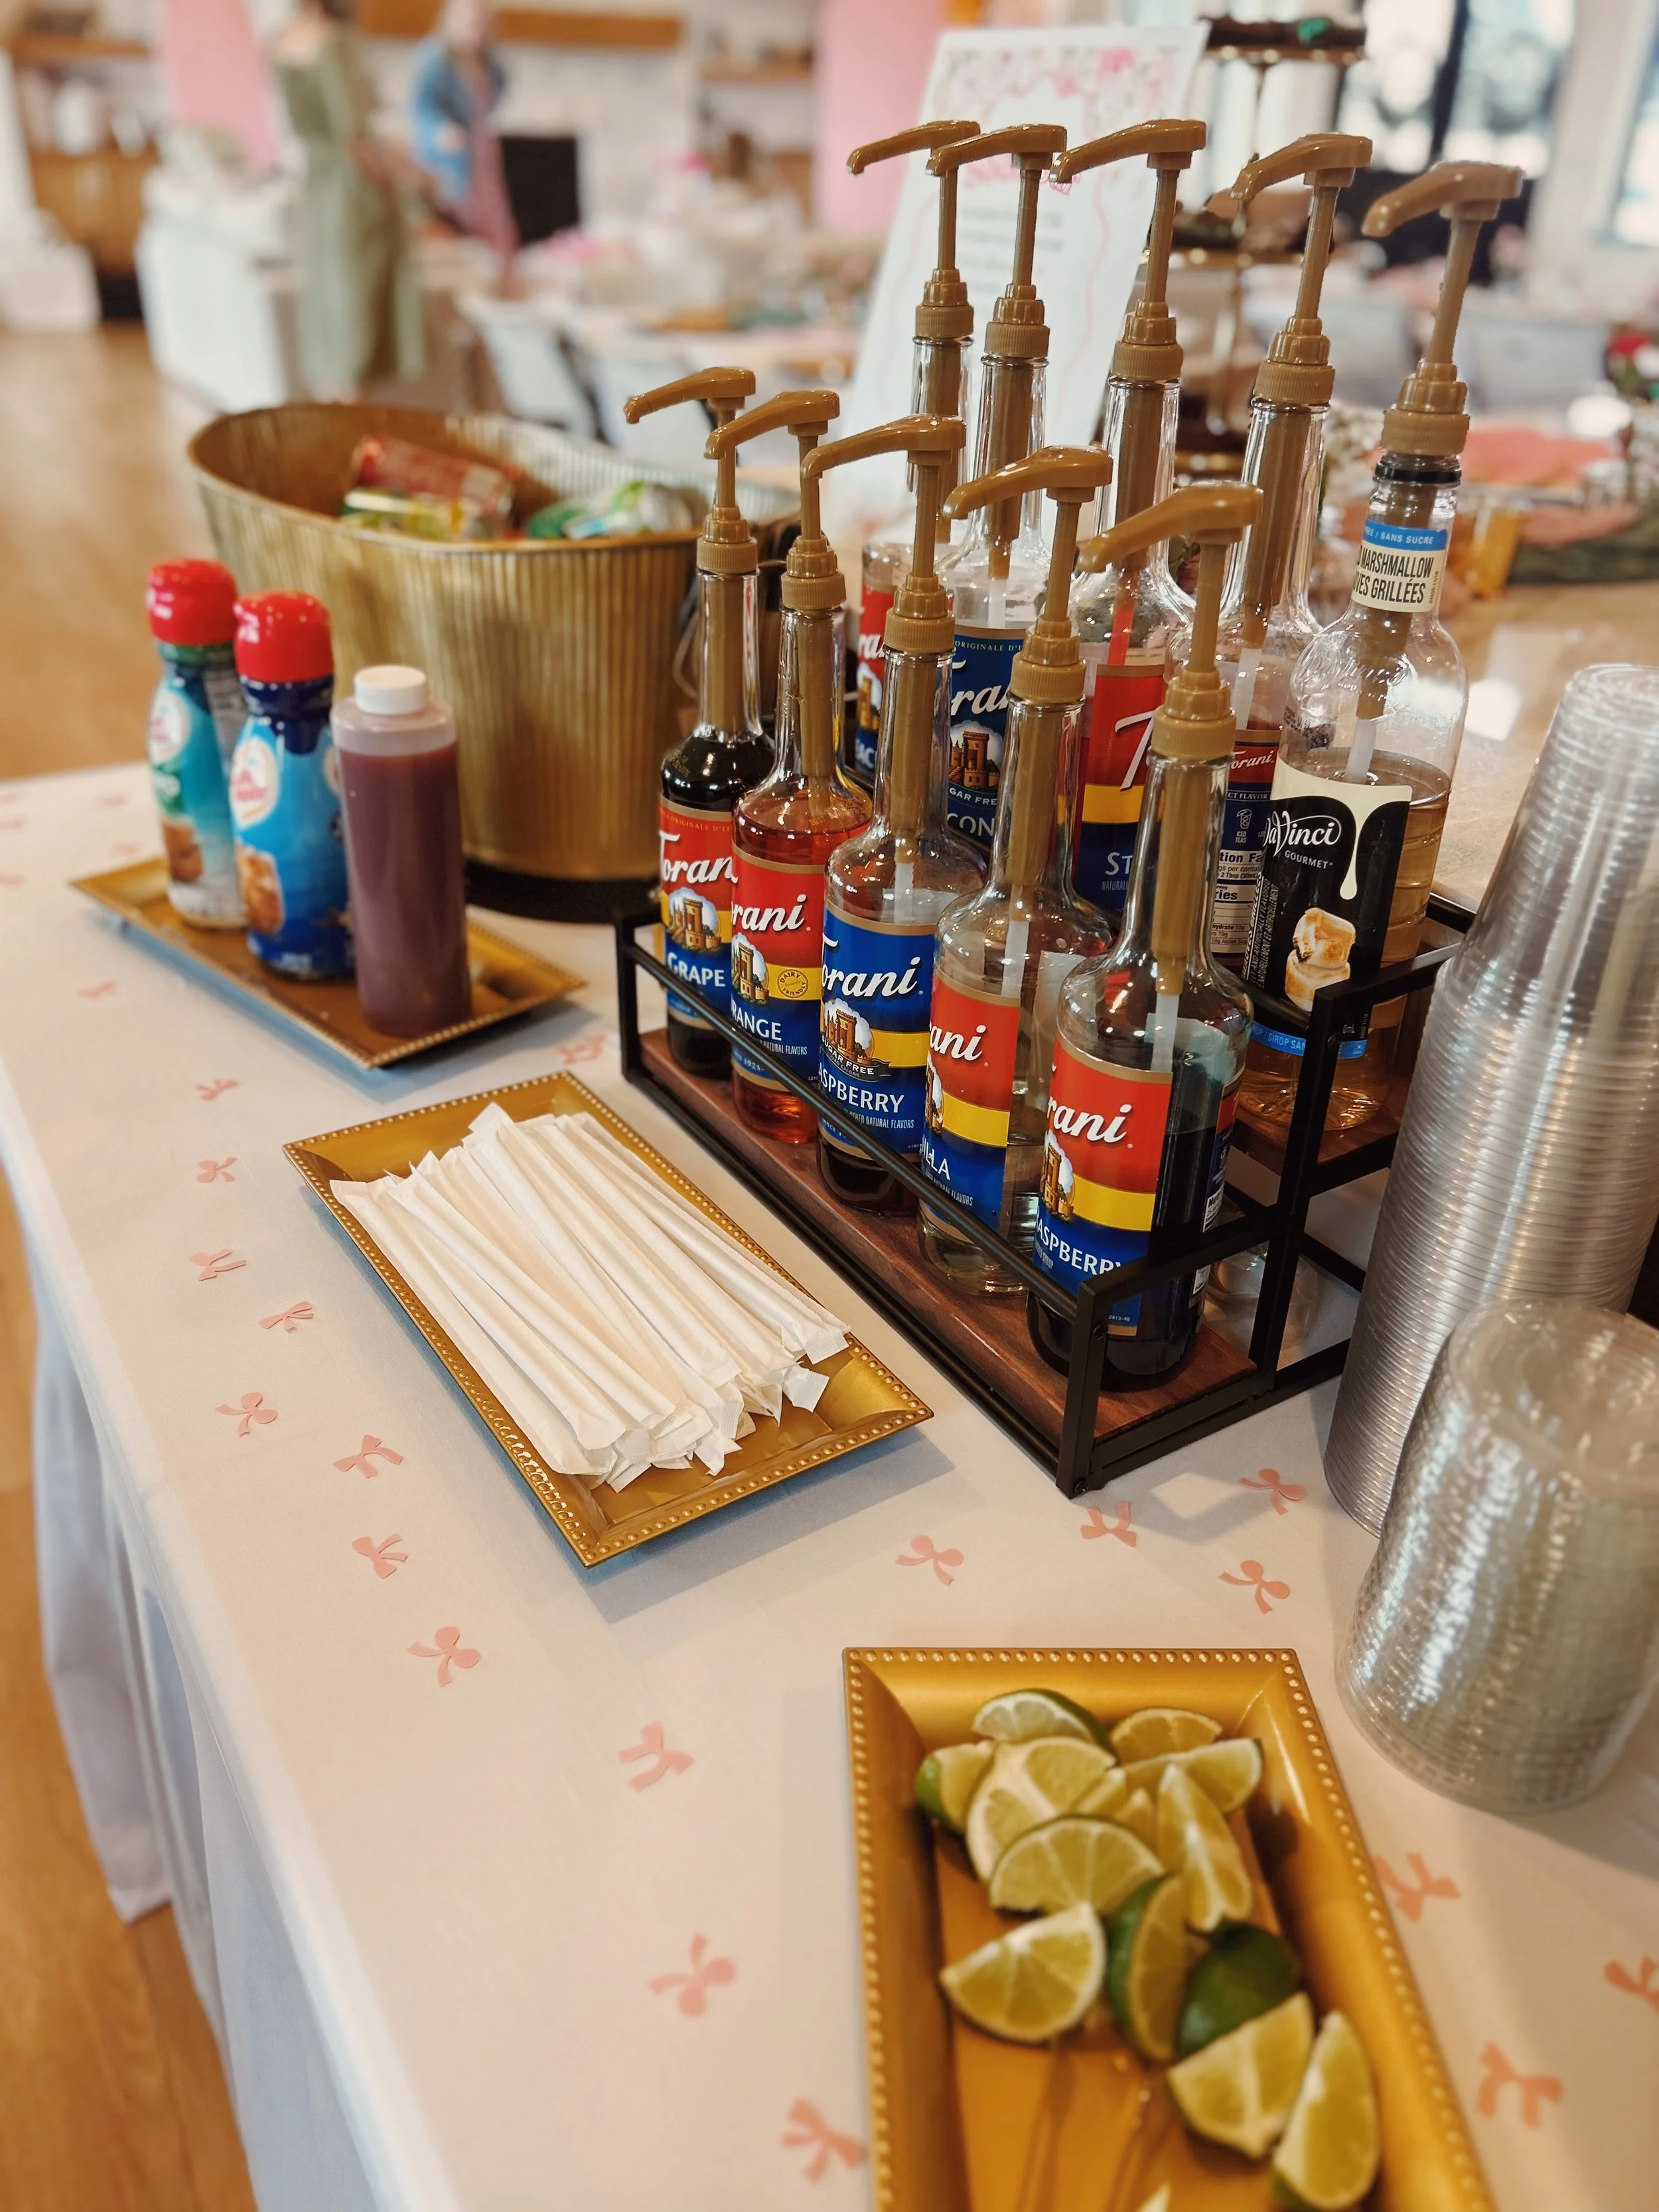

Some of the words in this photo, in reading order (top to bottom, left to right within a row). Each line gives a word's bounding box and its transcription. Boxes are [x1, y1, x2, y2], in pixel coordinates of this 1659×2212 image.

[1380, 532, 1403, 543] SANS
[1406, 535, 1434, 545] SUCRE
[1360, 547, 1435, 578] MARSHMALLOW
[1370, 577, 1426, 605] GRILLÉES
[955, 640, 1004, 652] ORIGINALE
[658, 829, 739, 884] Toran
[1105, 851, 1133, 875] ST
[1284, 849, 1329, 869] GOURMET
[731, 894, 807, 932] rani
[667, 952, 726, 988] GRAPE
[780, 972, 801, 984] DAIRY
[783, 982, 806, 995] FRIENDLY
[731, 997, 782, 1041] RANGE
[785, 1045, 808, 1055] FLAVORS
[822, 1035, 844, 1063] SUGAR
[845, 1061, 875, 1075] FREE
[1267, 1033, 1289, 1046] SIROP
[1291, 1040, 1306, 1051] SAN
[818, 1062, 904, 1114] ASPBERRY
[866, 1116, 889, 1128] NATURAL
[891, 1119, 914, 1129] FLAVORS
[1046, 1096, 1132, 1143] rani
[951, 1189, 974, 1207] FLAVORS
[1036, 1206, 1121, 1276] ASPBERR
